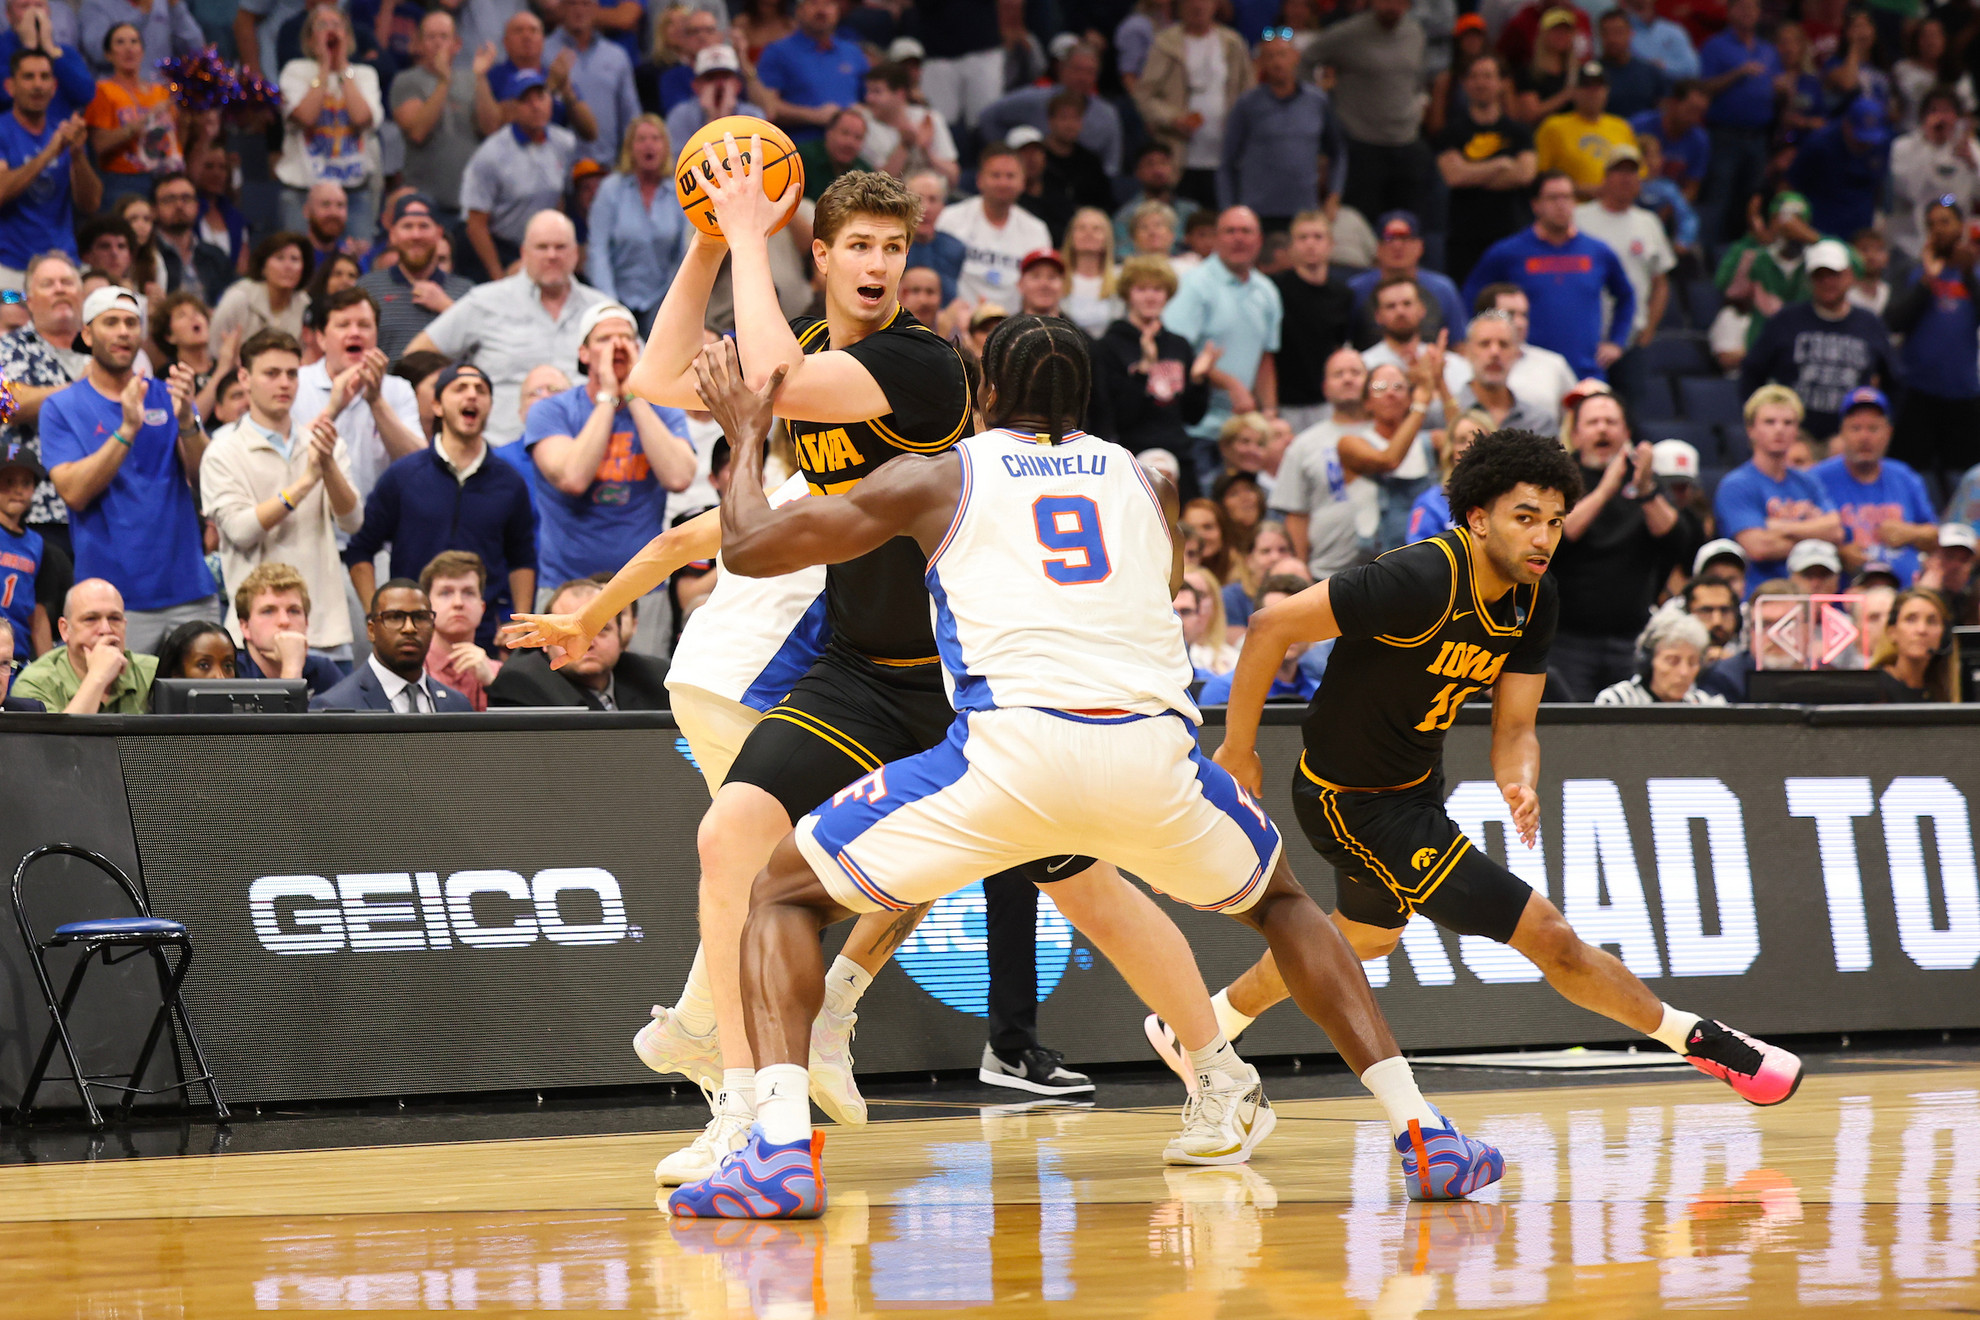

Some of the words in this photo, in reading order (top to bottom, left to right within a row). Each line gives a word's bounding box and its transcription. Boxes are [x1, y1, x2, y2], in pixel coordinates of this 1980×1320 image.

[1001, 454, 1107, 477] CHINYELU
[1032, 494, 1112, 586] 9
[248, 867, 629, 955] GEICO
[1784, 776, 1980, 973] TO
